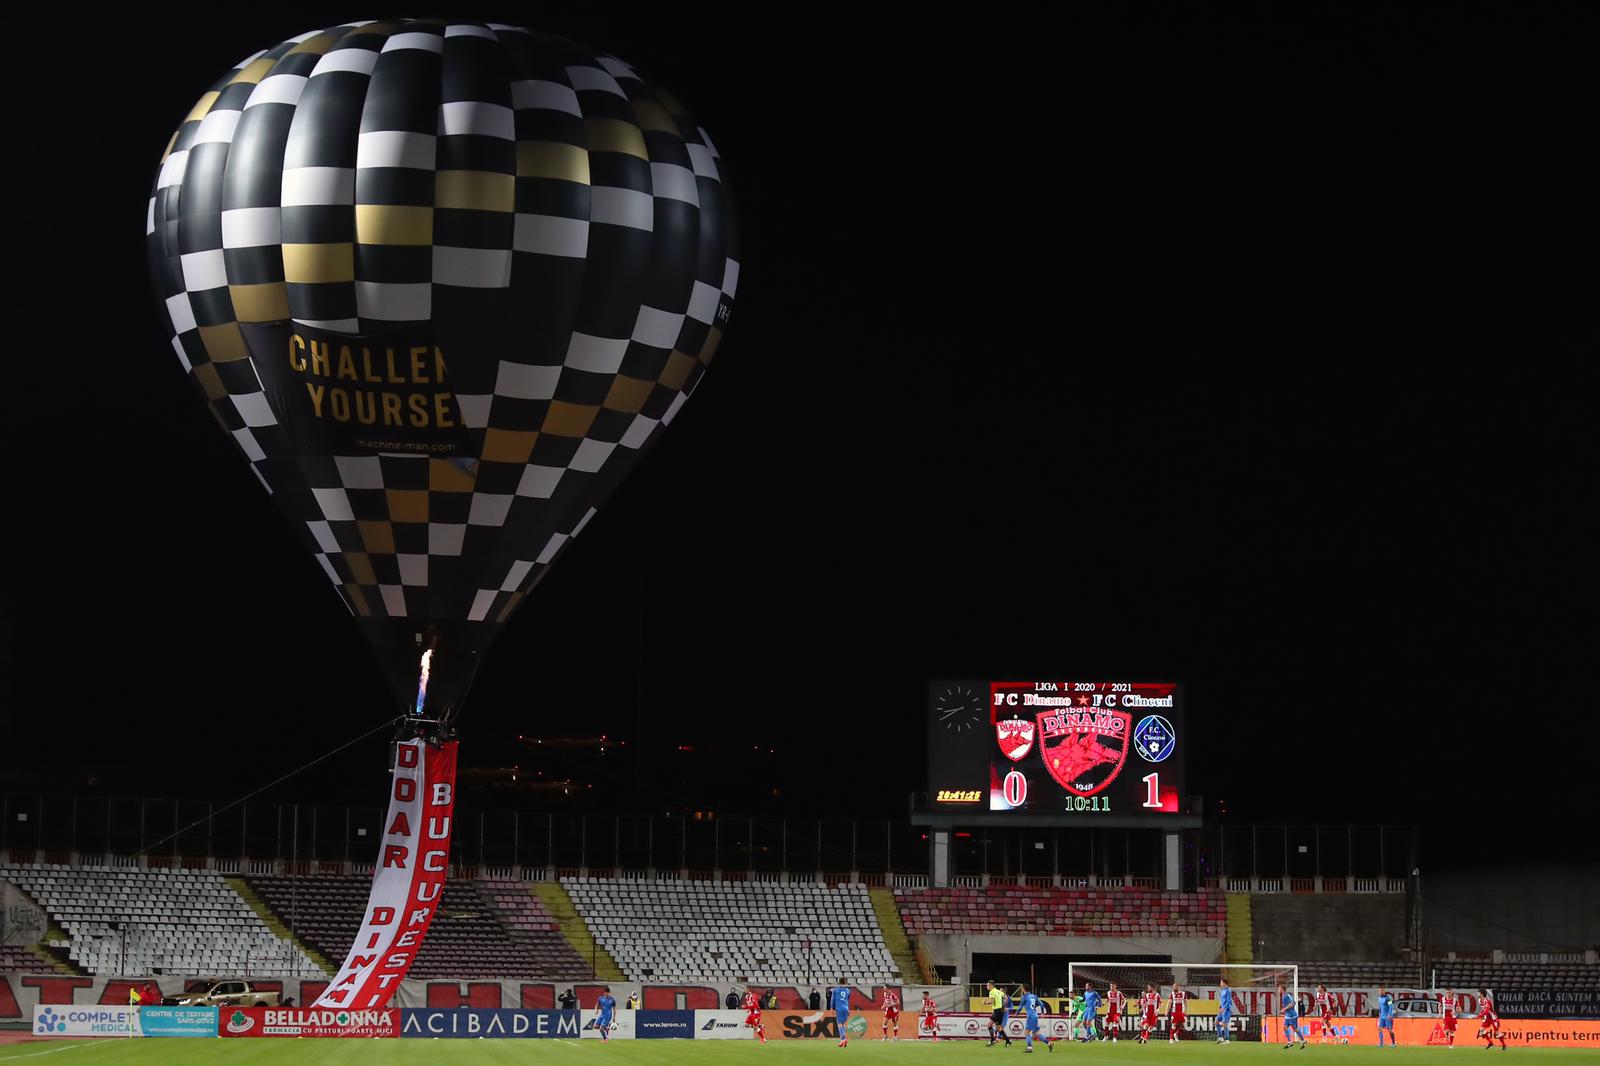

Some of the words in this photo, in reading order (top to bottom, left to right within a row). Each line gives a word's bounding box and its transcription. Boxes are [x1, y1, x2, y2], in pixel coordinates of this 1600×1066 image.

[306, 382, 467, 428] YOURSE
[356, 439, 456, 451] machine-man.com
[1035, 682, 1058, 692] LIGA
[1074, 682, 1096, 692] 2020
[1111, 683, 1132, 692] 2021
[1024, 693, 1072, 707] Dinamo
[1121, 693, 1173, 707] Clinceni
[1089, 706, 1113, 717] Club
[1044, 713, 1124, 732] DINAMO
[1148, 726, 1161, 734] F.C.
[1003, 771, 1027, 807] 0
[1075, 783, 1094, 791] 1948
[1142, 772, 1163, 808] 1
[383, 744, 418, 869] DOAR
[1065, 796, 1110, 811] 10:11
[840, 991, 847, 1001] 9
[1497, 992, 1524, 1001] CHIAR
[1555, 992, 1592, 1002] SUNTEM
[68, 1011, 135, 1023] COMPLET
[185, 1010, 215, 1018] TESTARE
[264, 1010, 392, 1026] BELLADONNA
[91, 1024, 137, 1032] MEDICAL
[403, 1012, 578, 1034] ACIBADEM
[1183, 1016, 1249, 1032] UNIET
[1526, 1030, 1569, 1043] pentru
